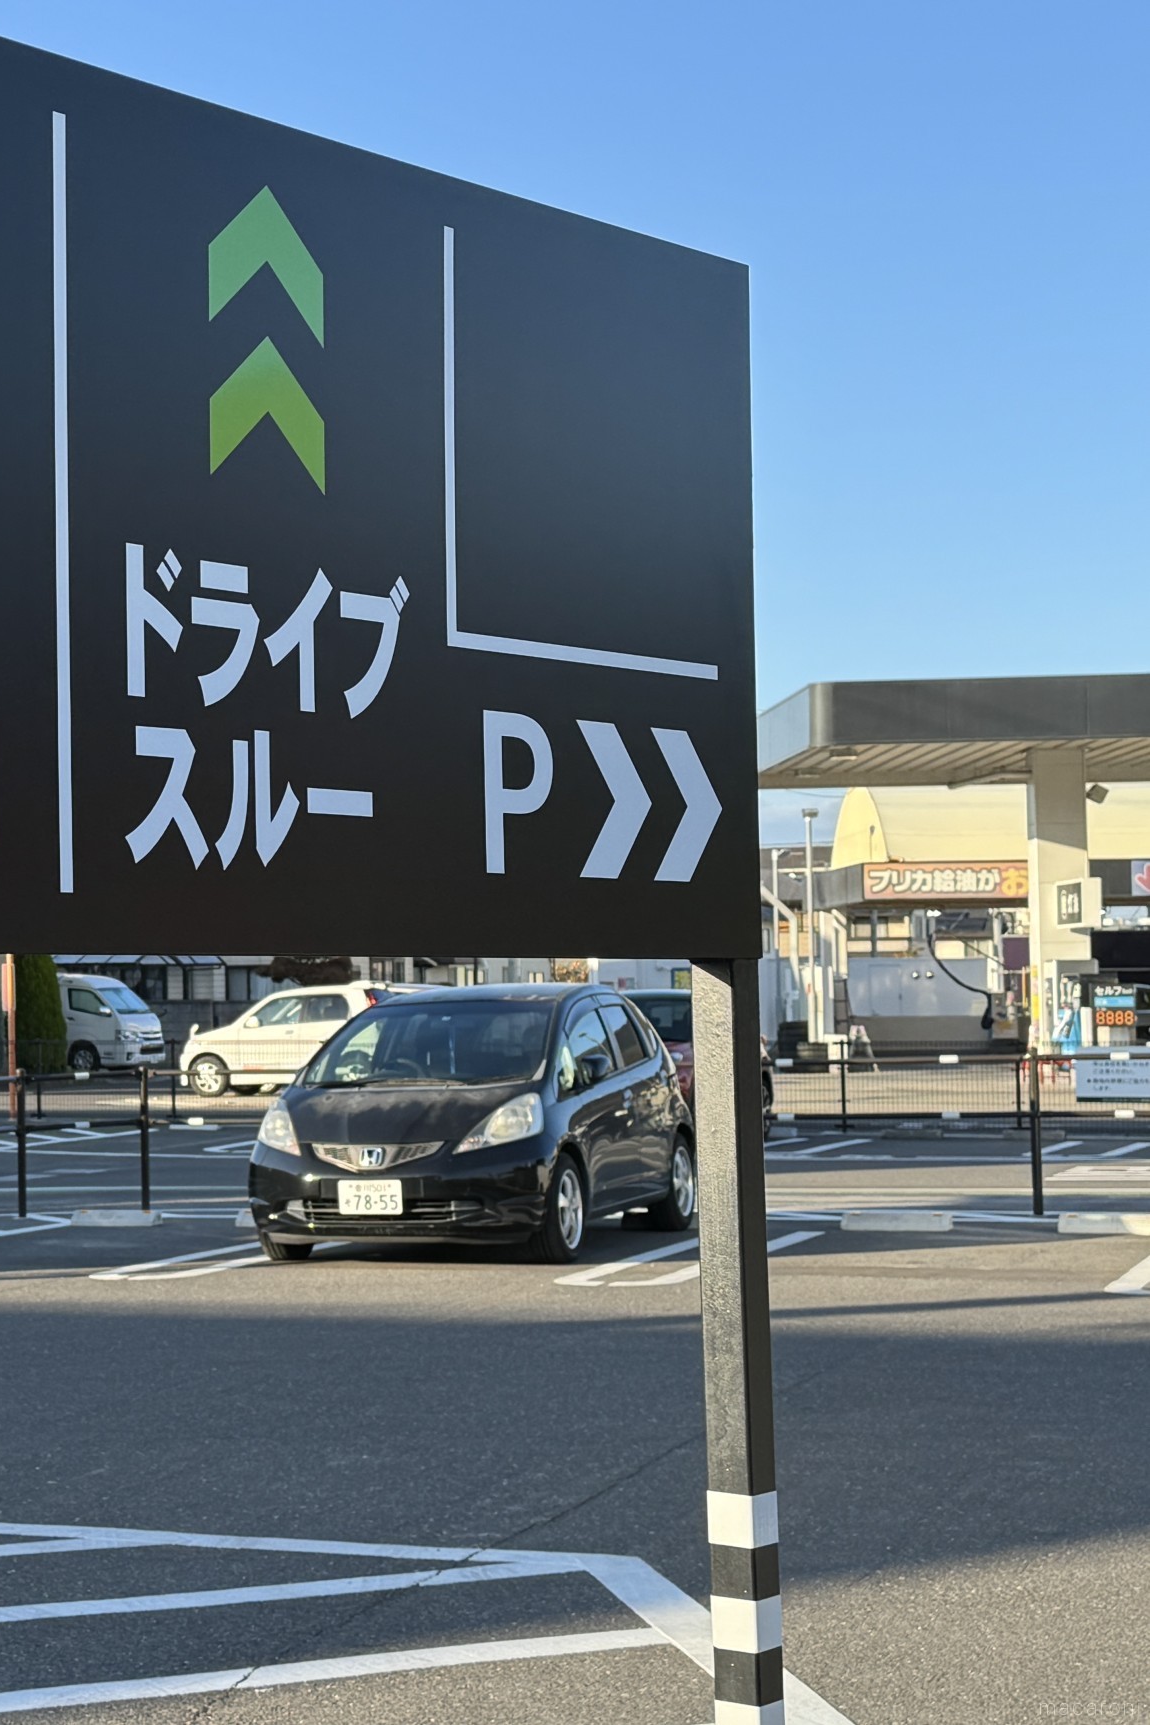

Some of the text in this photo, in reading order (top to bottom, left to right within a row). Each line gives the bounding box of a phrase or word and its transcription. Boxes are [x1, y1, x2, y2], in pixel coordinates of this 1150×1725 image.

[125, 542, 409, 719] ドライブ
[125, 726, 373, 870] スルー
[483, 709, 554, 874] P
[353, 1195, 398, 1211] 78-55
